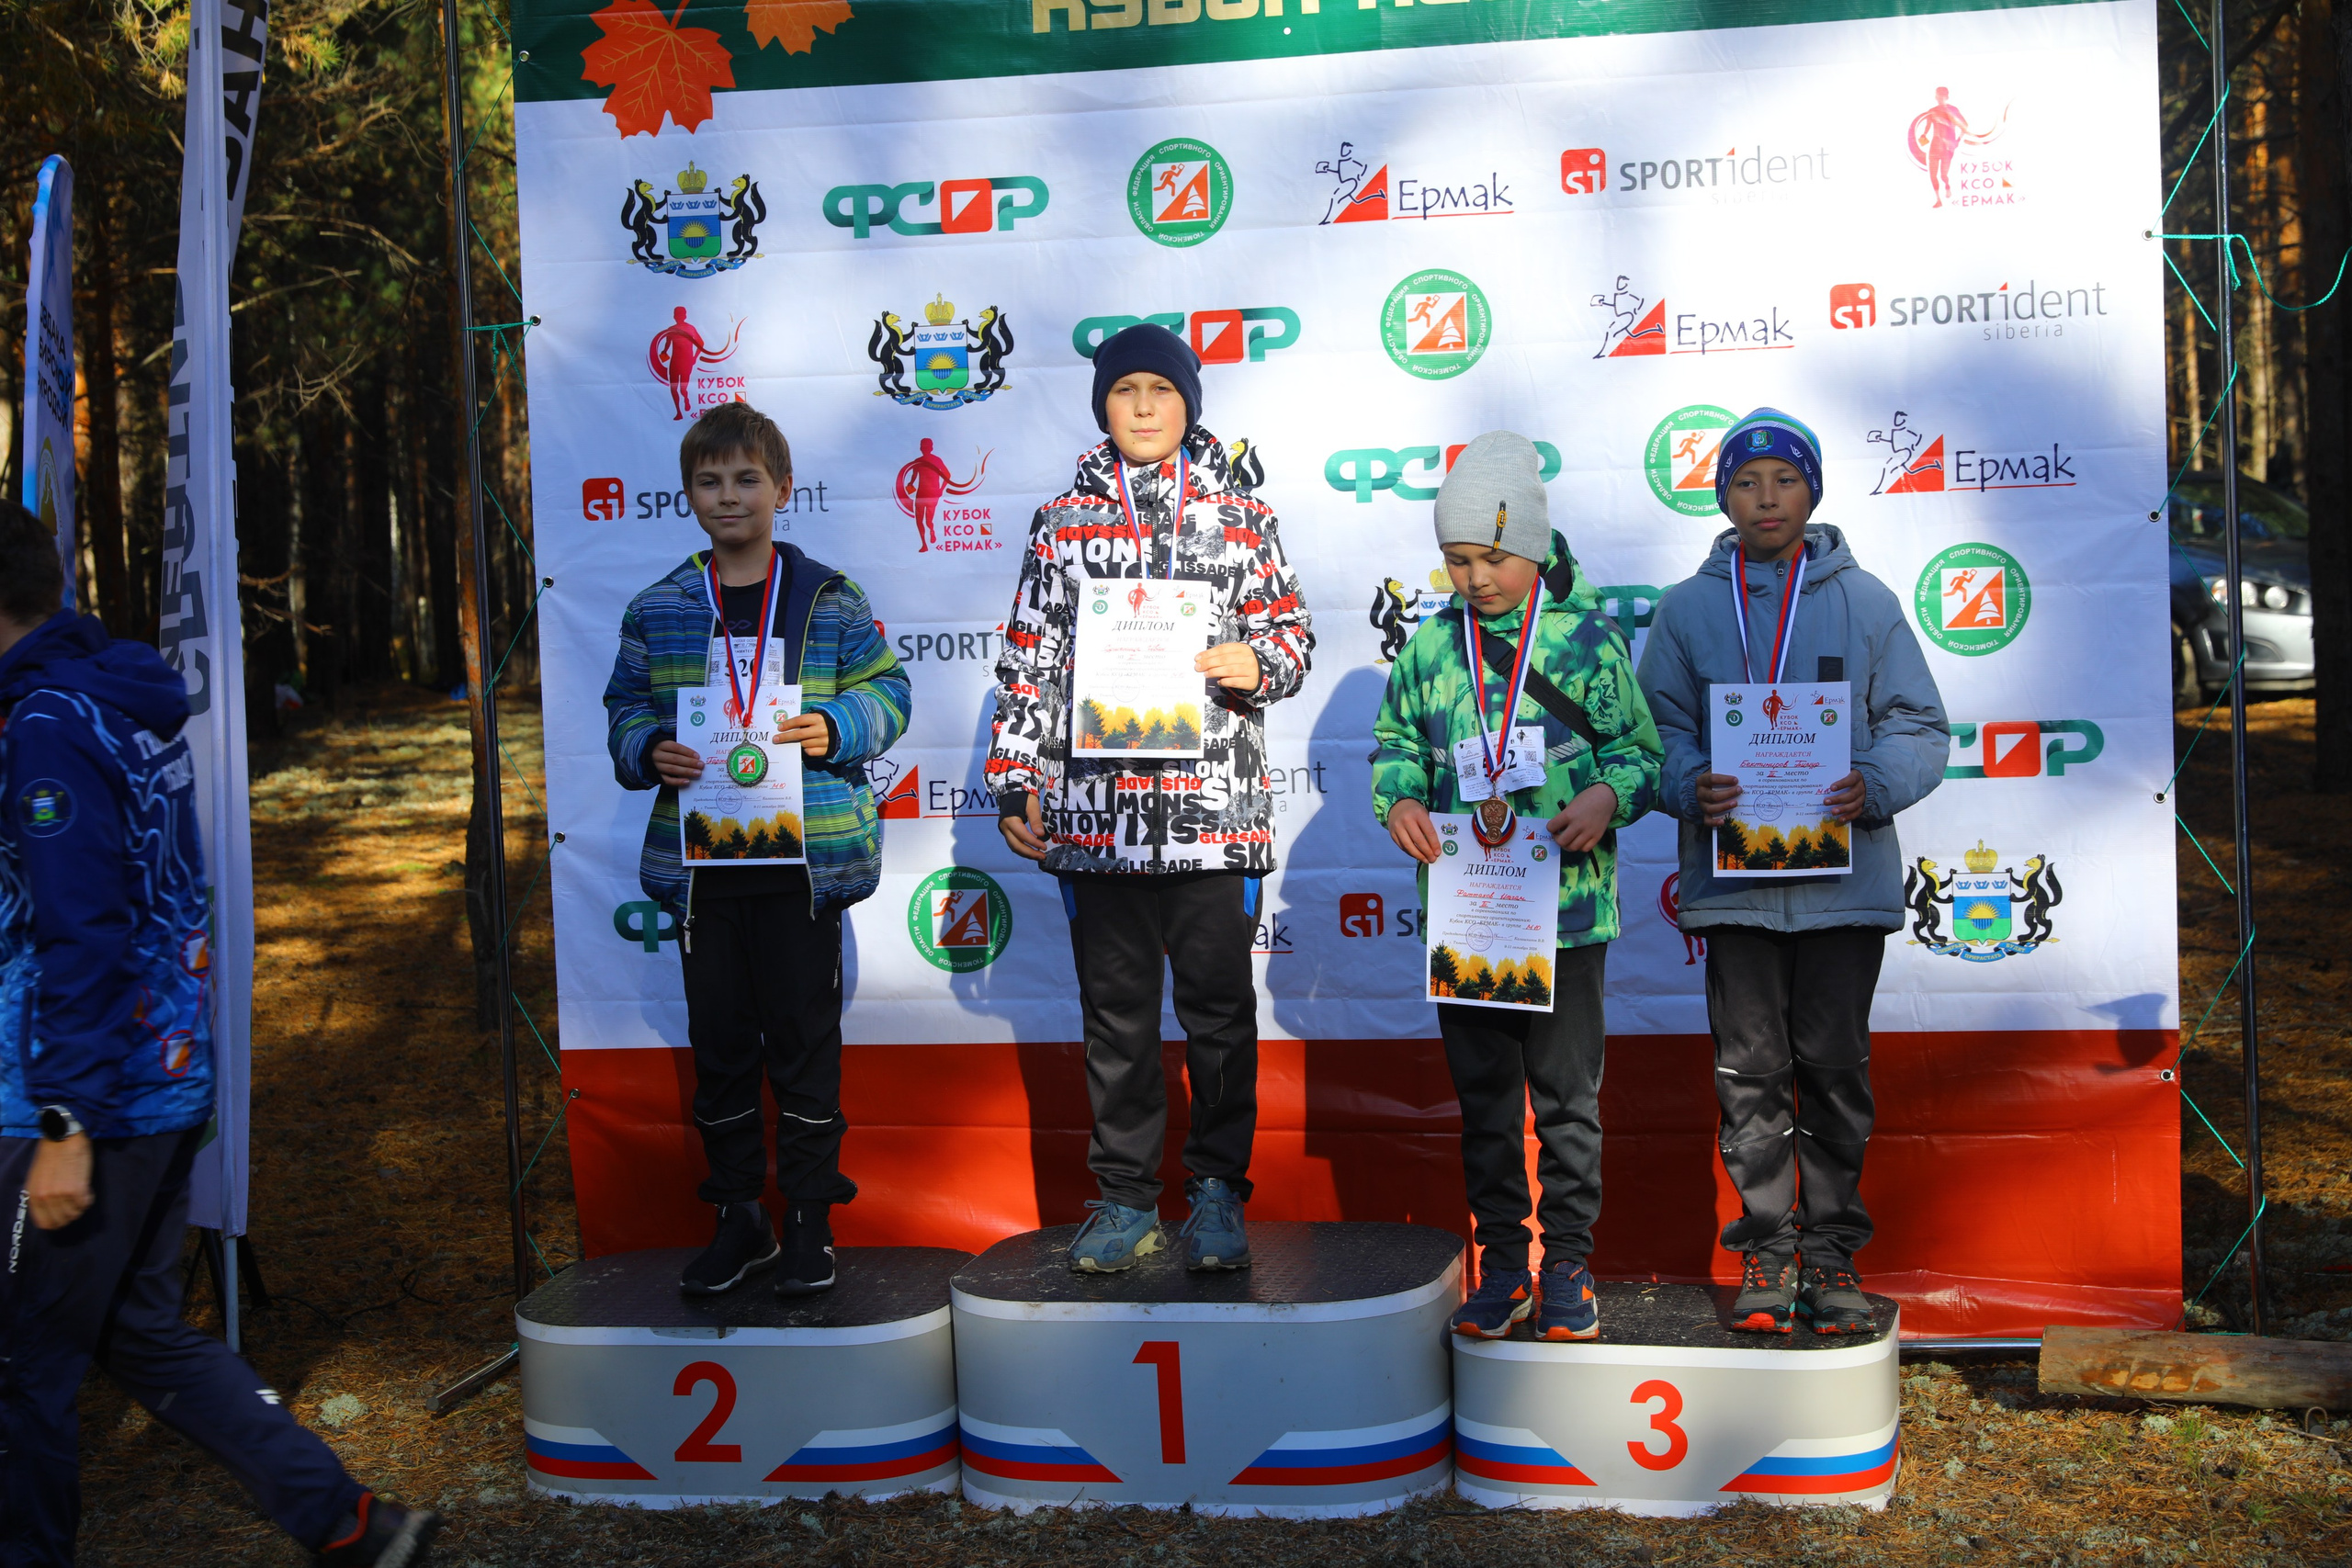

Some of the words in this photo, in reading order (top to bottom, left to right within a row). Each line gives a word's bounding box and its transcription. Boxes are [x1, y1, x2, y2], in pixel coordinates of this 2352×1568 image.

[1159, 143, 1212, 158] СПОРТИВНОГО
[1132, 154, 1156, 197] ФЕДЕРАЦИЯ
[1620, 145, 1831, 192] SPORTident
[1961, 160, 2013, 174] КУБОК
[1208, 162, 1229, 229] ОРИЕНТИРОВАНИЯ
[1398, 172, 1513, 220] Ермак
[1961, 178, 1995, 190] КСО
[1133, 201, 1154, 232] ОБЛАСТИ
[1158, 231, 1204, 243] ТЮМЕНСКОЙ
[1413, 274, 1468, 289] СПОРТИВНОГО
[1385, 285, 1409, 328] ФЕДЕРАЦИЯ
[1890, 279, 2108, 327] SPORTident
[1465, 294, 1487, 362] ОРИЕНТИРОВАНИЯ
[1677, 307, 1793, 355] Ермак
[1983, 321, 2064, 341] siberia
[1385, 333, 1408, 364] ОБЛАСТИ
[697, 376, 745, 389] КУБОК
[1412, 363, 1461, 375] ТЮМЕНСКОЙ
[697, 392, 729, 404] КСО
[1649, 421, 1674, 464] ФЕДЕРАЦИЯ
[1678, 410, 1735, 426] СПОРТИВНОГО
[1955, 443, 2076, 492] Ермак
[1650, 468, 1673, 501] ОБЛАСТИ
[943, 508, 991, 522] КУБОК
[944, 525, 975, 536] КСО
[935, 539, 1002, 552] «ЕРМАК»
[1949, 547, 2007, 564] СПОРТИВНОГО
[1920, 558, 1946, 602] ФЕДЕРАЦИЯ
[2004, 568, 2026, 637] ОРИЕНТИРОВАНИЯ
[1112, 620, 1175, 632] ДИПЛОМ
[1920, 606, 1943, 639] ОБЛАСТИ
[1948, 639, 1999, 651] ТЮМЕНСКОЙ
[709, 731, 770, 744] ДИПЛОМ
[1748, 733, 1817, 747] ДИПЛОМ
[929, 780, 999, 820] Ерм
[1047, 812, 1117, 835] SNOW
[1224, 842, 1273, 870] SKI
[1464, 863, 1527, 878] ДИПЛОМ
[938, 871, 989, 887] СПОРТИВНОГО
[1469, 882, 1522, 891] НАГРАЖДАЕТСЯ
[912, 881, 935, 921] ФЕДЕРАЦИЯ
[988, 891, 1008, 956] ОРИЕНТИРОВАНИЯ
[913, 926, 934, 957] ОБЛАСТИ
[938, 957, 984, 968] ТЮМЕНСКОЙ
[673, 1361, 742, 1463] 2
[1134, 1341, 1185, 1465] 1
[1626, 1380, 1689, 1472] 3
